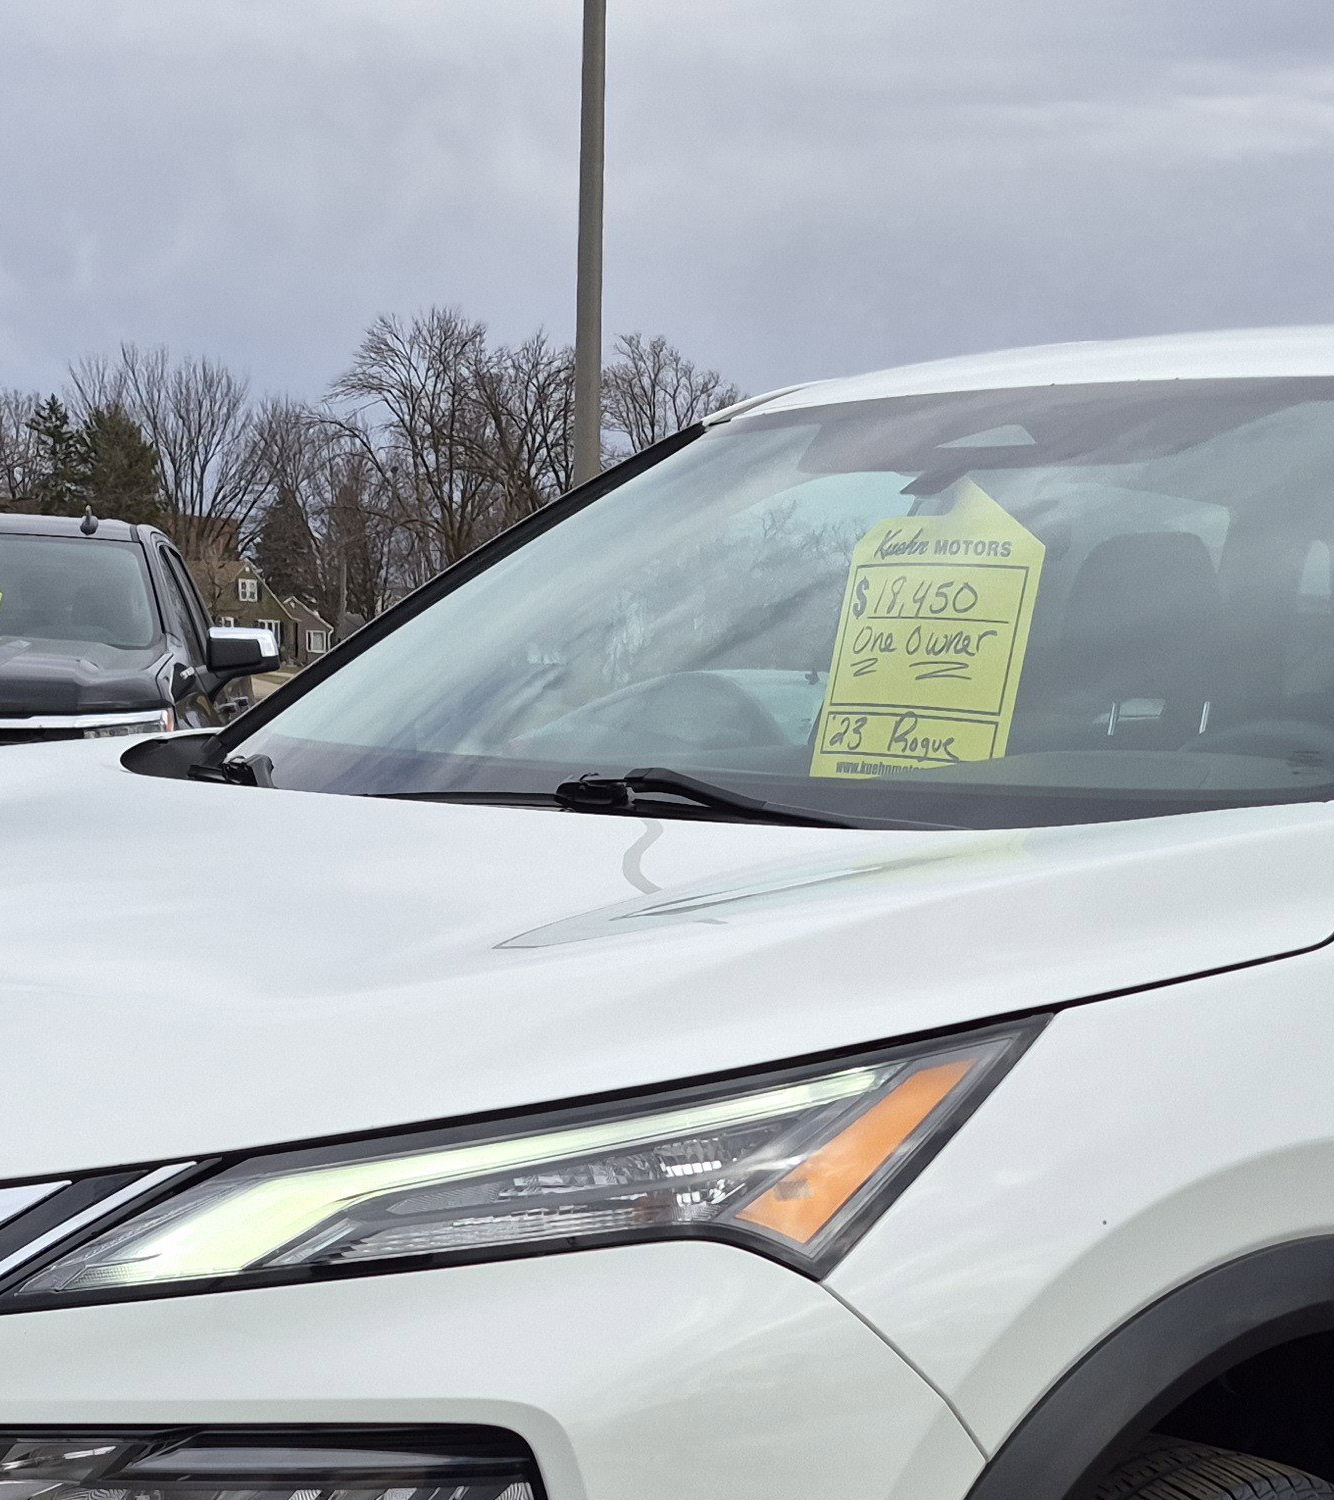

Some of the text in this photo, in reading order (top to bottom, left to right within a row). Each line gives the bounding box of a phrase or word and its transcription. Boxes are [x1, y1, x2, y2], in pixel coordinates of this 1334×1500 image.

[873, 528, 1012, 560] Kuehn MOTORS
[852, 625, 998, 657] One Owner
[887, 711, 959, 762] Rogue
